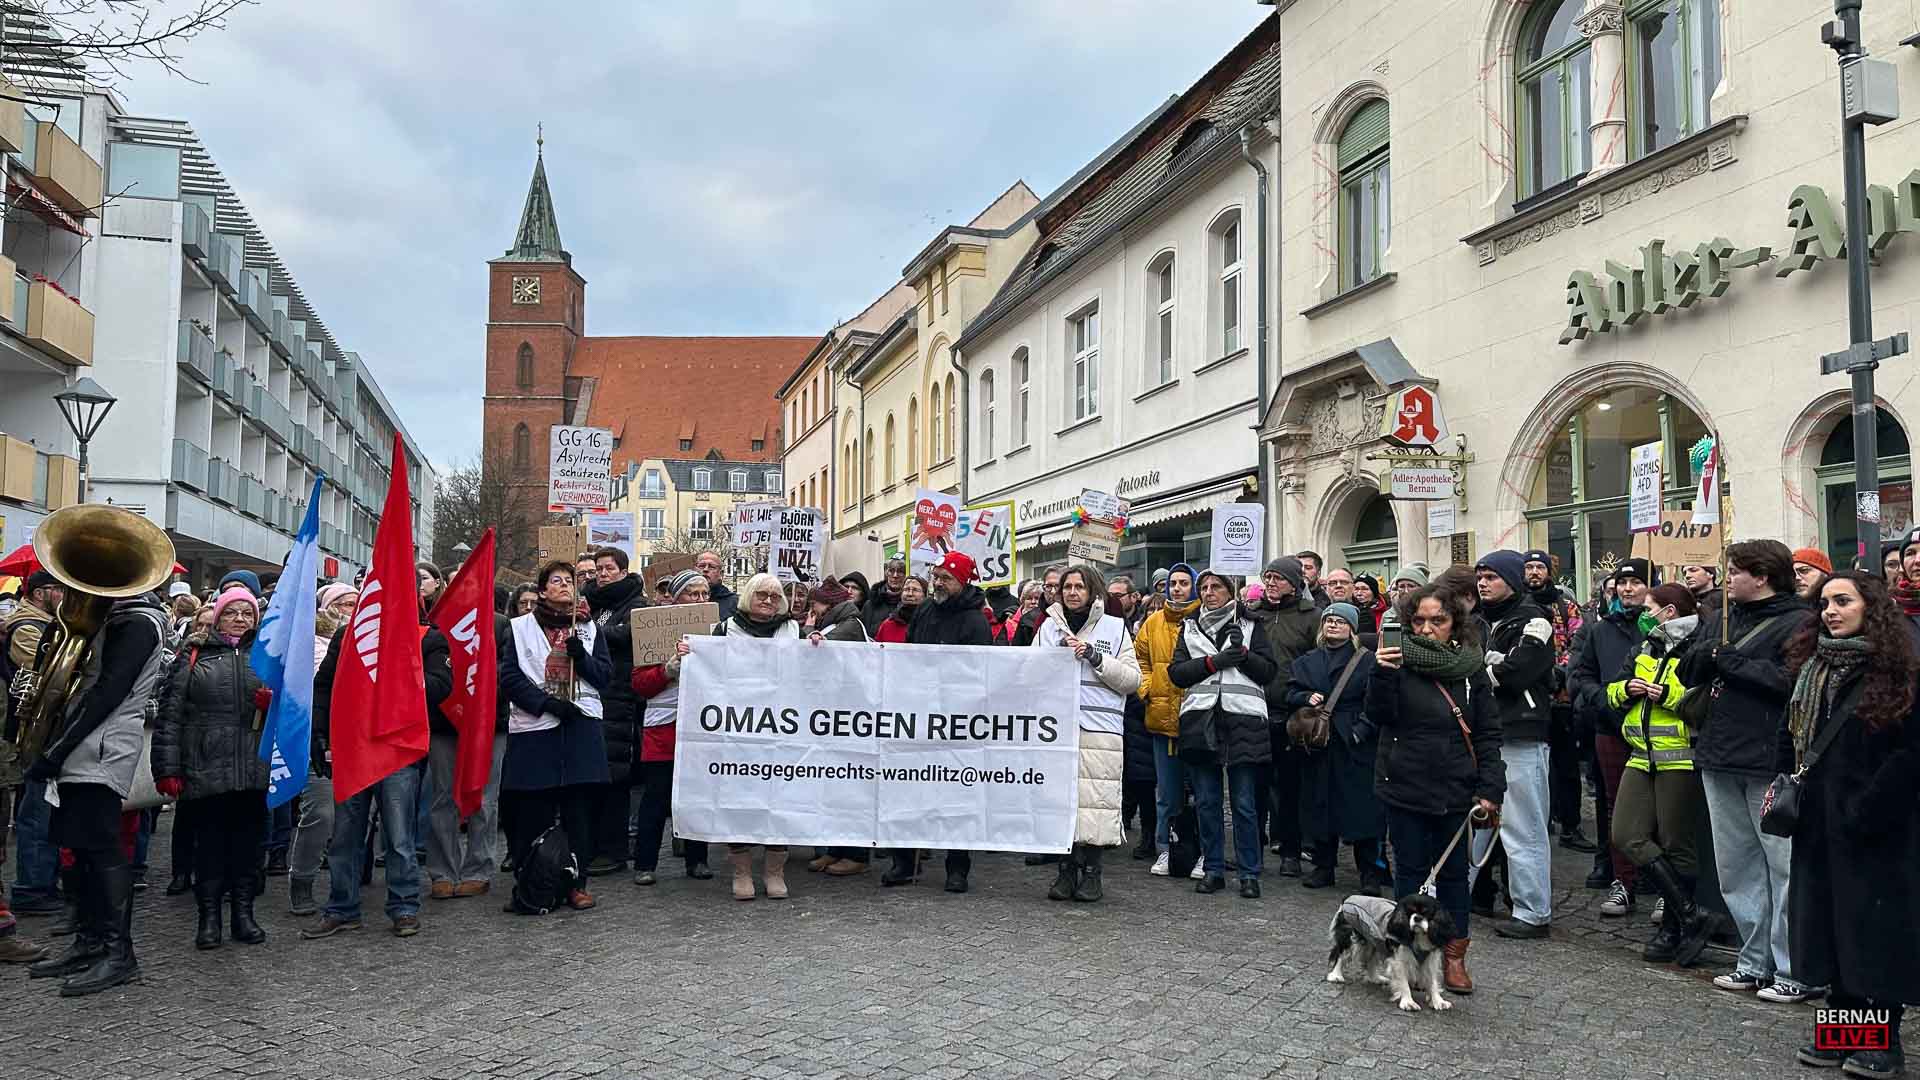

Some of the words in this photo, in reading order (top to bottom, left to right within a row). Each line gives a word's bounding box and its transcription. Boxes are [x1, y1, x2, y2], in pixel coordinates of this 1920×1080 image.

[558, 429, 581, 447] GG
[586, 433, 601, 447] 16
[556, 447, 611, 467] Asylrecht
[560, 467, 610, 480] schützen!
[1632, 459, 1660, 478] NIEMALS
[553, 479, 604, 492] Rechtsrutsch
[1114, 470, 1160, 497] Antonia
[1393, 473, 1452, 485] Adler-Apotheke
[1636, 477, 1651, 493] AfD
[1408, 484, 1436, 493] Bernau
[557, 491, 608, 505] VERHINDERN
[740, 509, 754, 523] NIE
[757, 508, 773, 522] WIE
[780, 510, 815, 527] BJÖRN
[919, 504, 935, 515] HERZ
[940, 510, 954, 520] statt
[926, 517, 944, 529] Hetze
[1675, 520, 1712, 539] AfD
[741, 530, 754, 544] IST
[780, 525, 814, 543] HÖCKE
[778, 548, 812, 569] NAZI
[700, 704, 800, 736] OMAS
[809, 709, 916, 741] GEGEN
[927, 714, 1059, 743] RECHTS
[708, 761, 1045, 787] omasgegenrechts-wandlitz@web.de
